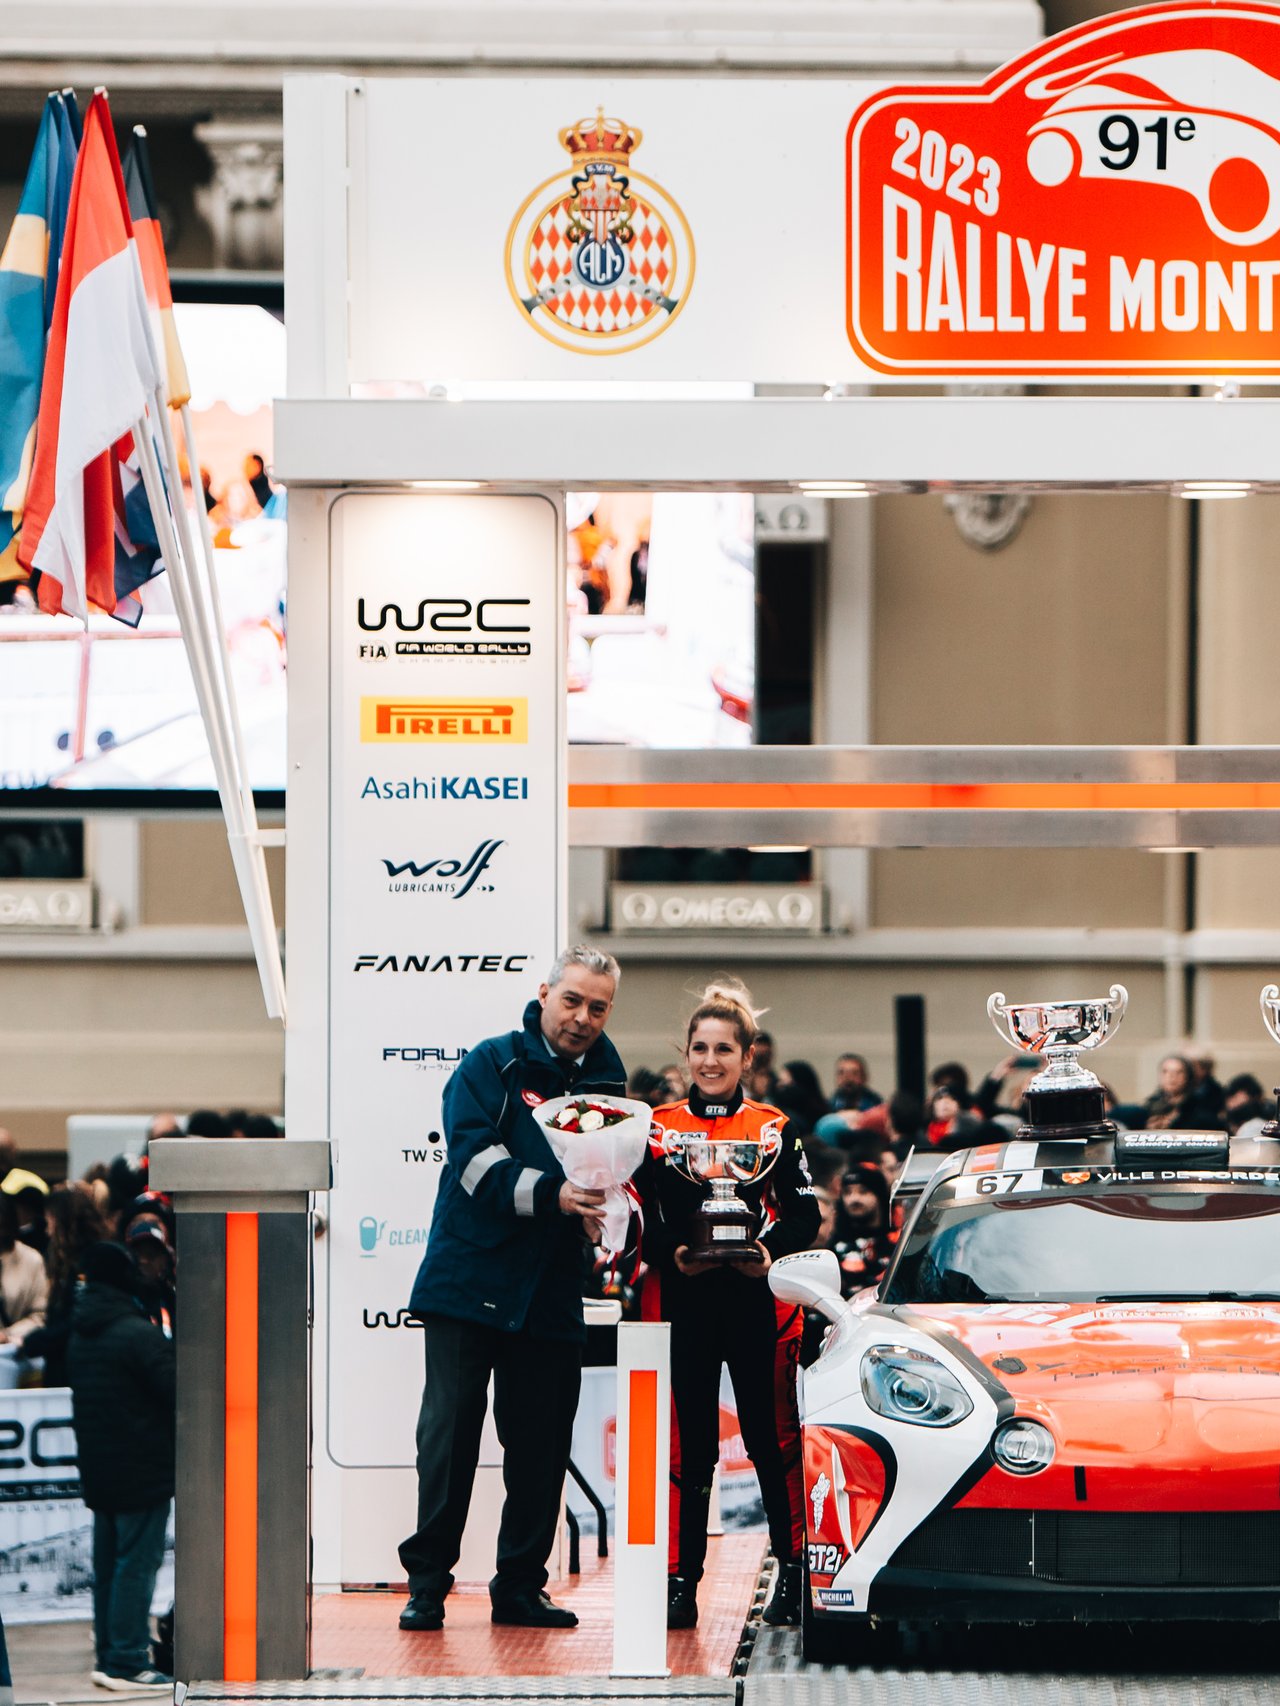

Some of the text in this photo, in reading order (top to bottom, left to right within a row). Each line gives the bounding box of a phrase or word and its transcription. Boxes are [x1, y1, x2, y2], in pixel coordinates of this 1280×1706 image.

[890, 116, 1001, 217] 2023
[882, 183, 1087, 332] RALLYE
[358, 598, 531, 632] WRC
[397, 643, 528, 653] FIA WORLD RALLY
[376, 704, 514, 734] PIRELLI
[389, 883, 456, 893] LUBRICANTS
[661, 896, 775, 927] OMEGA
[353, 955, 528, 972] FANATEC
[401, 1149, 427, 1162] TW
[975, 1173, 1023, 1195] 67
[1098, 1171, 1154, 1181] VILLE
[1161, 1170, 1190, 1179] DE
[808, 1544, 843, 1573] GT2i
[820, 1592, 853, 1602] MICHELIN
